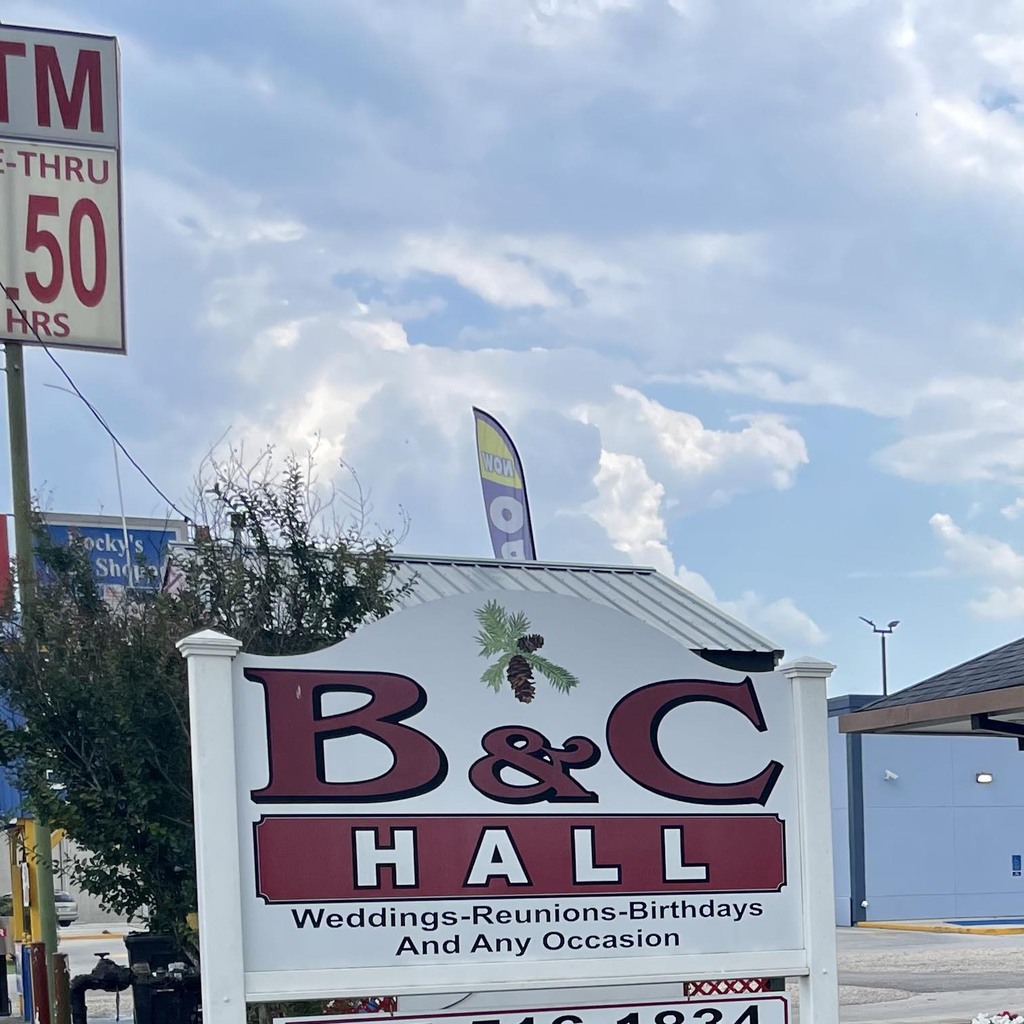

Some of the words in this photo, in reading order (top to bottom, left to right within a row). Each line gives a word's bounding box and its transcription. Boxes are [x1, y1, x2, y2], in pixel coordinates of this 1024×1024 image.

[6, 308, 71, 337] HRS
[68, 531, 144, 557] ocky's
[95, 557, 166, 584] Shopp
[243, 667, 785, 807] B&C
[352, 825, 711, 890] HALL
[291, 899, 764, 932] Weddings-Reunions-Birthdays
[395, 934, 460, 956] And
[470, 933, 532, 957] Any
[542, 929, 680, 951] Occasion
